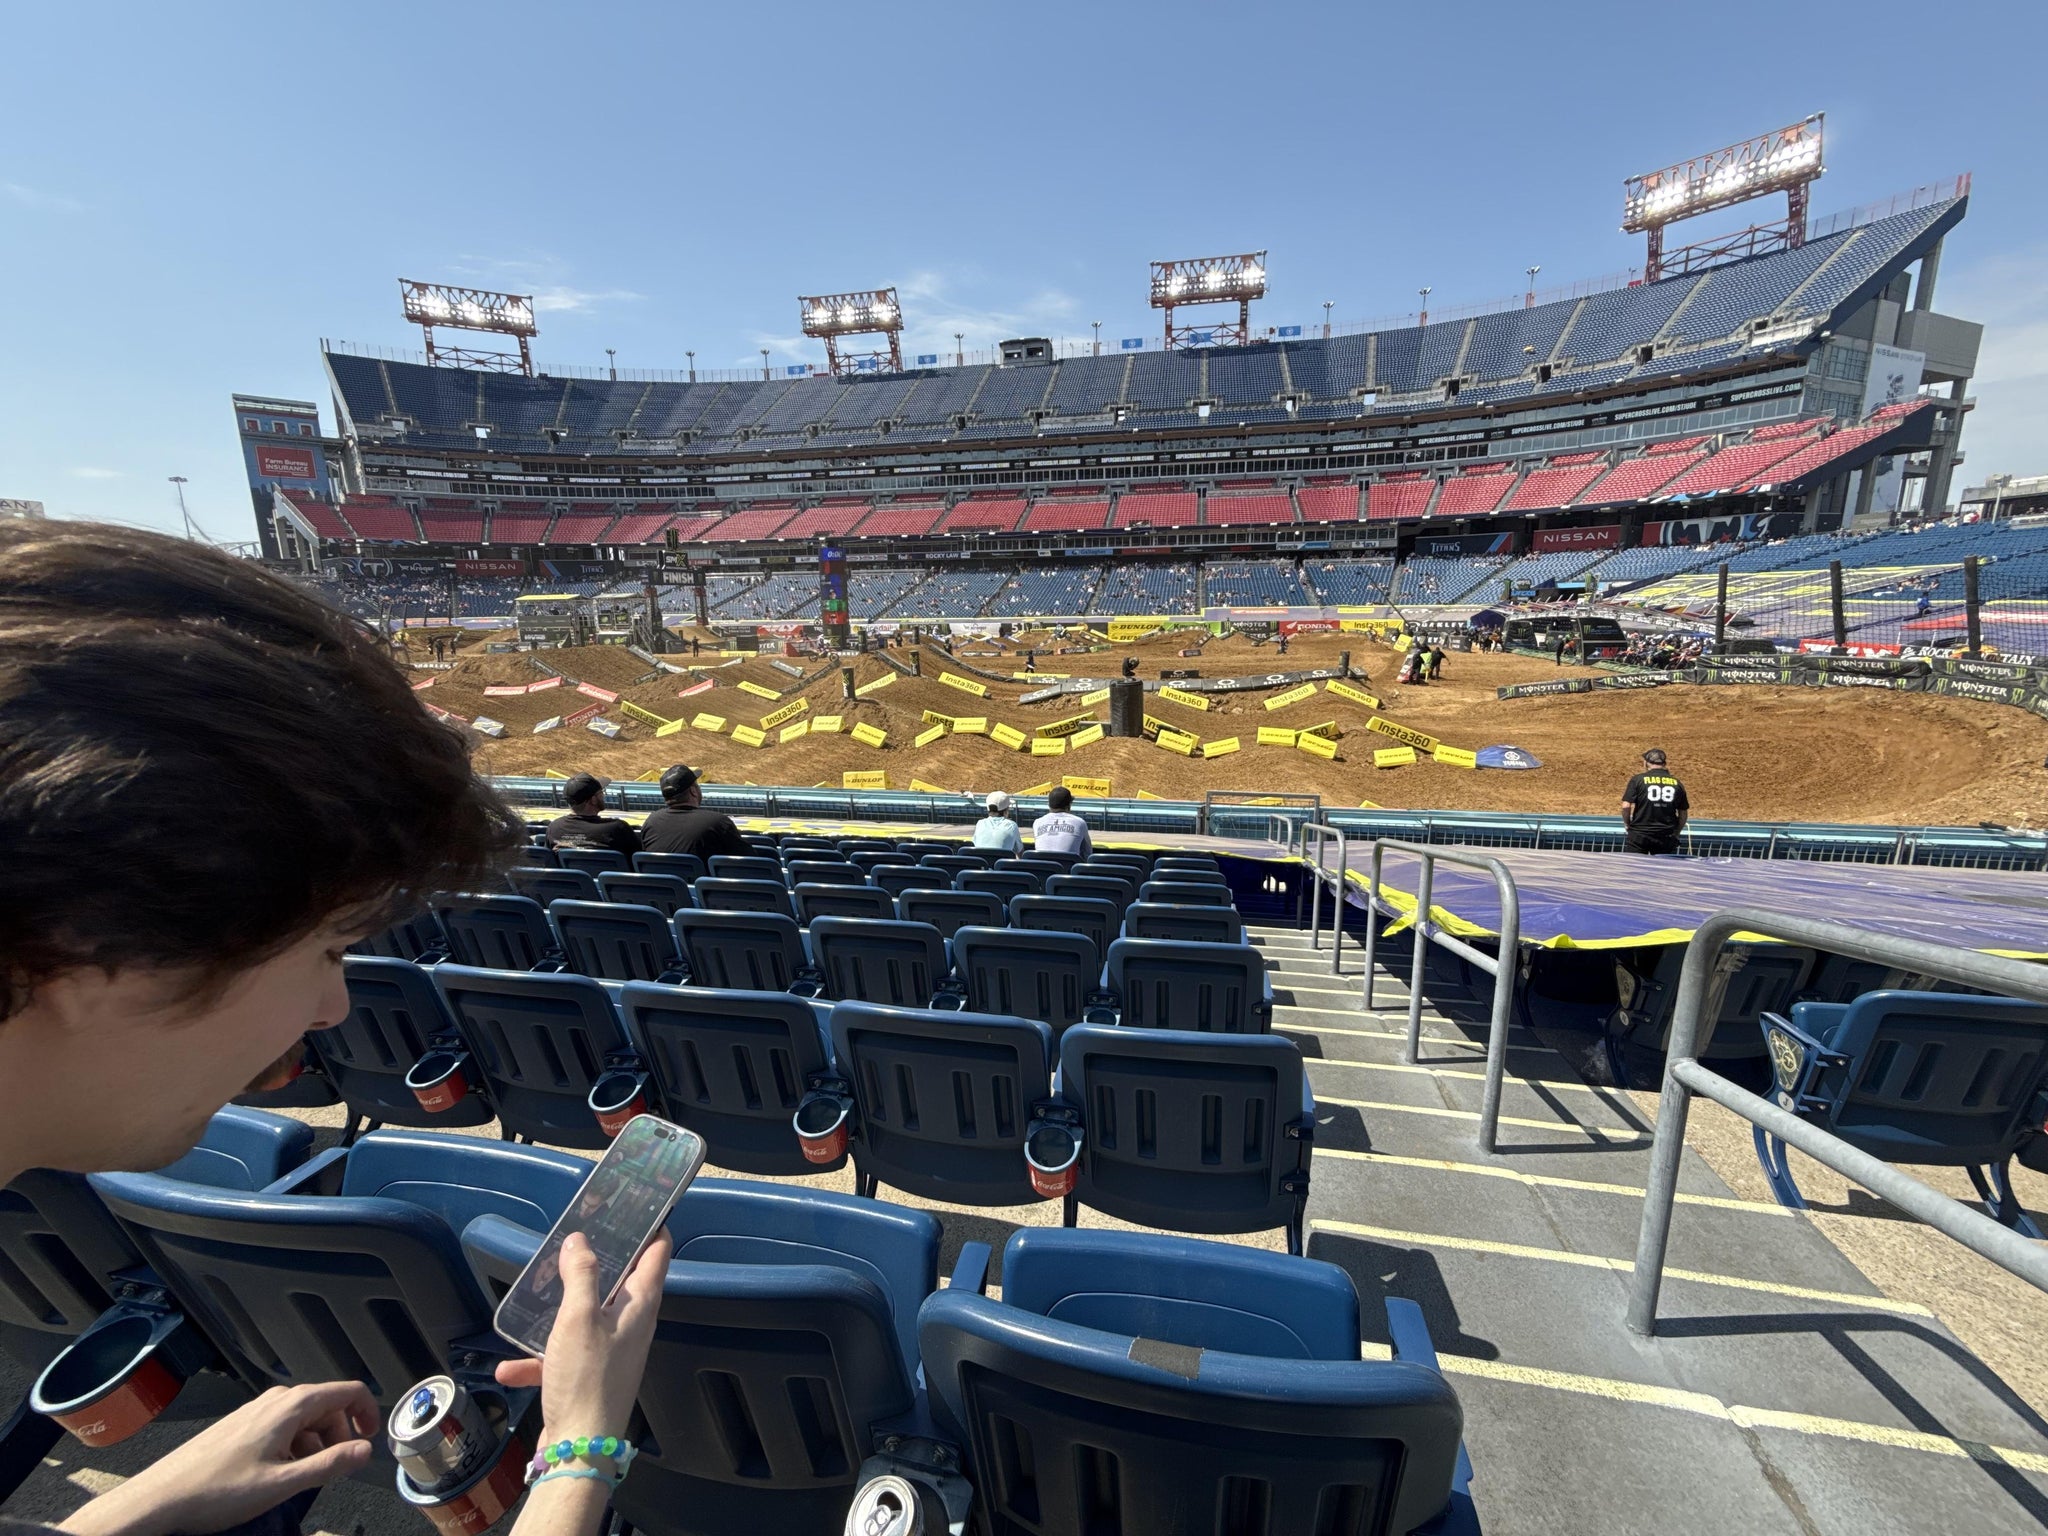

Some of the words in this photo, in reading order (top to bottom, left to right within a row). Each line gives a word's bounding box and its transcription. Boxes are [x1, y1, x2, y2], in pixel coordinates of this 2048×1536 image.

[265, 464, 309, 473] INSURANCE
[1543, 531, 1609, 543] NISSAN
[663, 571, 694, 584] FINISH
[1724, 656, 1775, 664] MONSTER
[1721, 670, 1776, 679] MONSTER
[1959, 663, 2012, 676] MONSTER
[945, 675, 980, 692] Insta360
[1518, 683, 1565, 693] MONSTER
[1951, 680, 2008, 697] MONSTER
[1087, 691, 1108, 702] Insta
[1165, 690, 1202, 707] Insta360
[1271, 687, 1309, 706] Insta360
[1334, 683, 1372, 704] Insta360
[569, 708, 600, 726] HONDA
[627, 706, 665, 727] Insta360
[766, 702, 802, 726] Insta360
[929, 714, 954, 728] Insta
[1378, 721, 1431, 748] Insta360
[1643, 776, 1661, 785] FLAG
[1661, 776, 1678, 786] CREW
[1071, 784, 1108, 792] DUNLOP
[1647, 785, 1675, 802] 08
[1782, 1097, 1788, 1106] J
[1036, 1179, 1069, 1191] Coca-Cola
